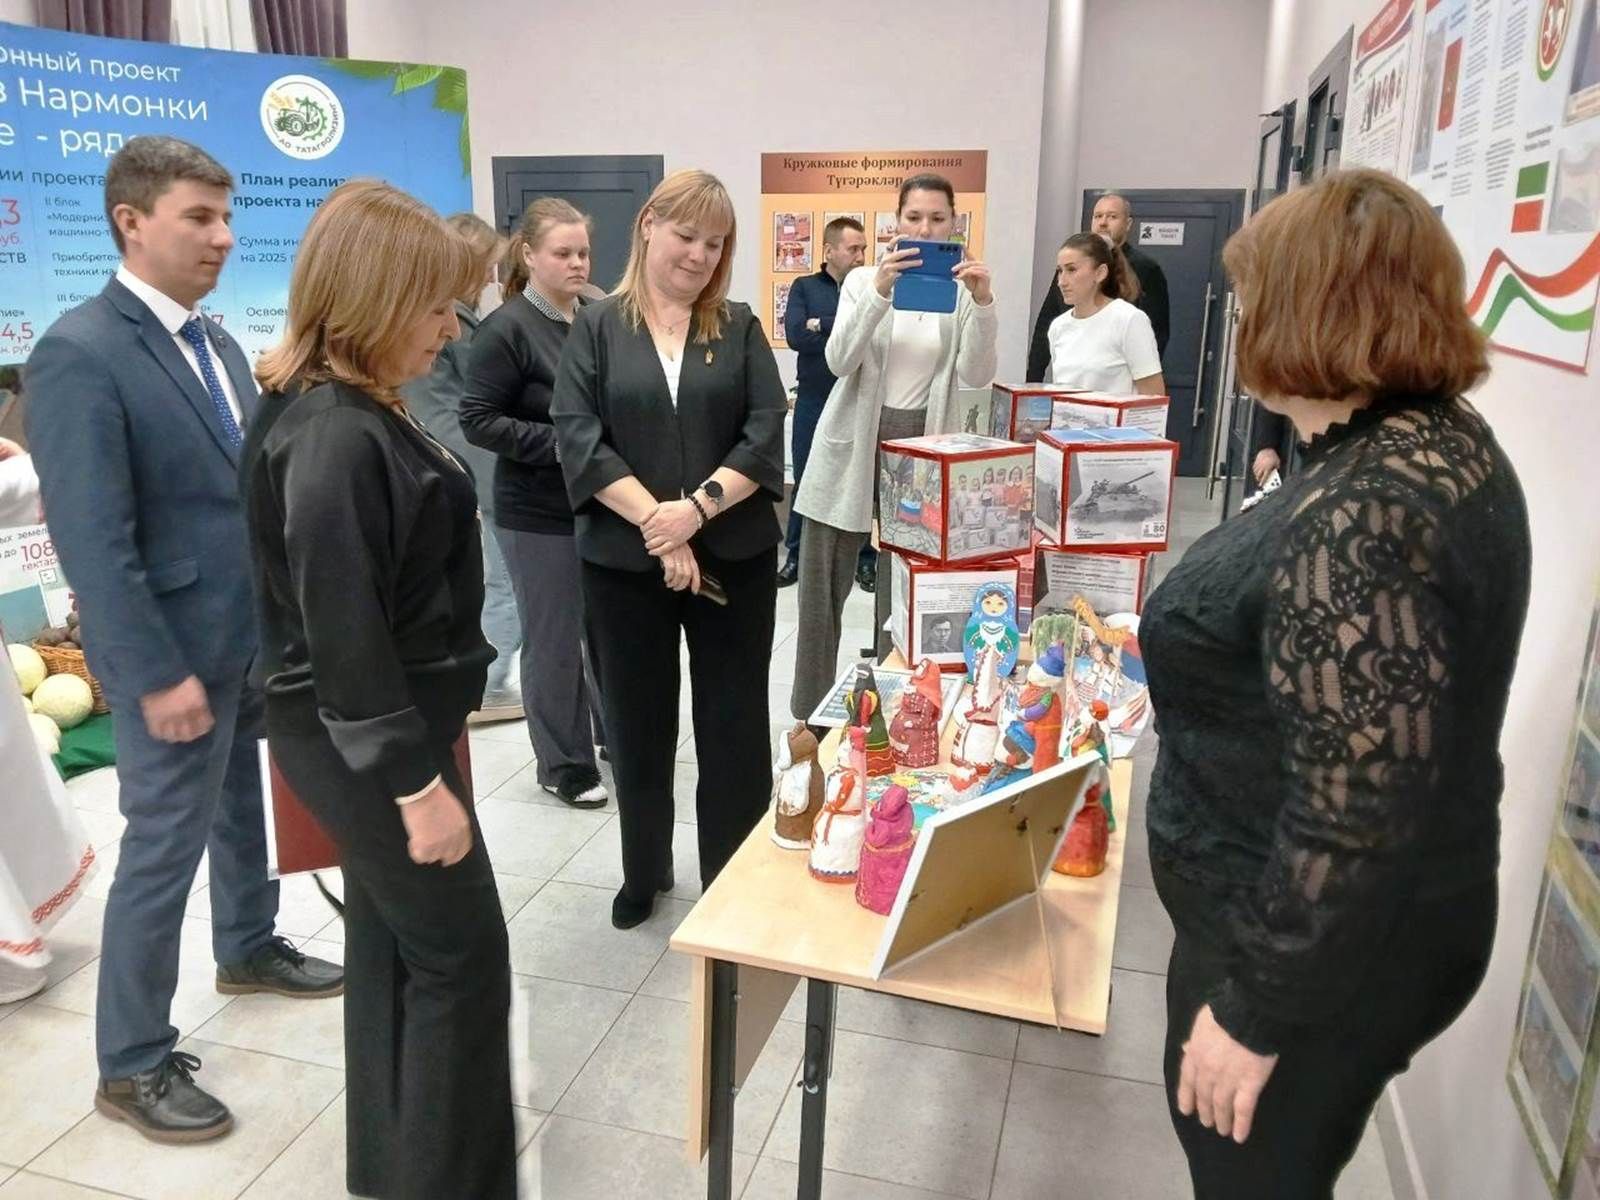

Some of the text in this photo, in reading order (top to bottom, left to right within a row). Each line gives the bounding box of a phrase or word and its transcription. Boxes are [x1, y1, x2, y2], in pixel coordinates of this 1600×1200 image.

[90, 59, 181, 83] проект
[18, 76, 209, 121] Нармонки
[60, 129, 136, 158] ряд
[783, 155, 963, 172] Кружковые формирования
[32, 171, 106, 187] проекта
[241, 173, 346, 189] План реализ
[54, 197, 81, 207] блок
[233, 196, 324, 208] проекта на
[47, 213, 106, 224] «Модерни
[49, 229, 113, 237] машинно-т
[239, 236, 301, 249] Сумма ин
[52, 252, 123, 263] Приобретен
[241, 254, 256, 262] на
[258, 253, 287, 263] 2025
[248, 324, 275, 335] году
